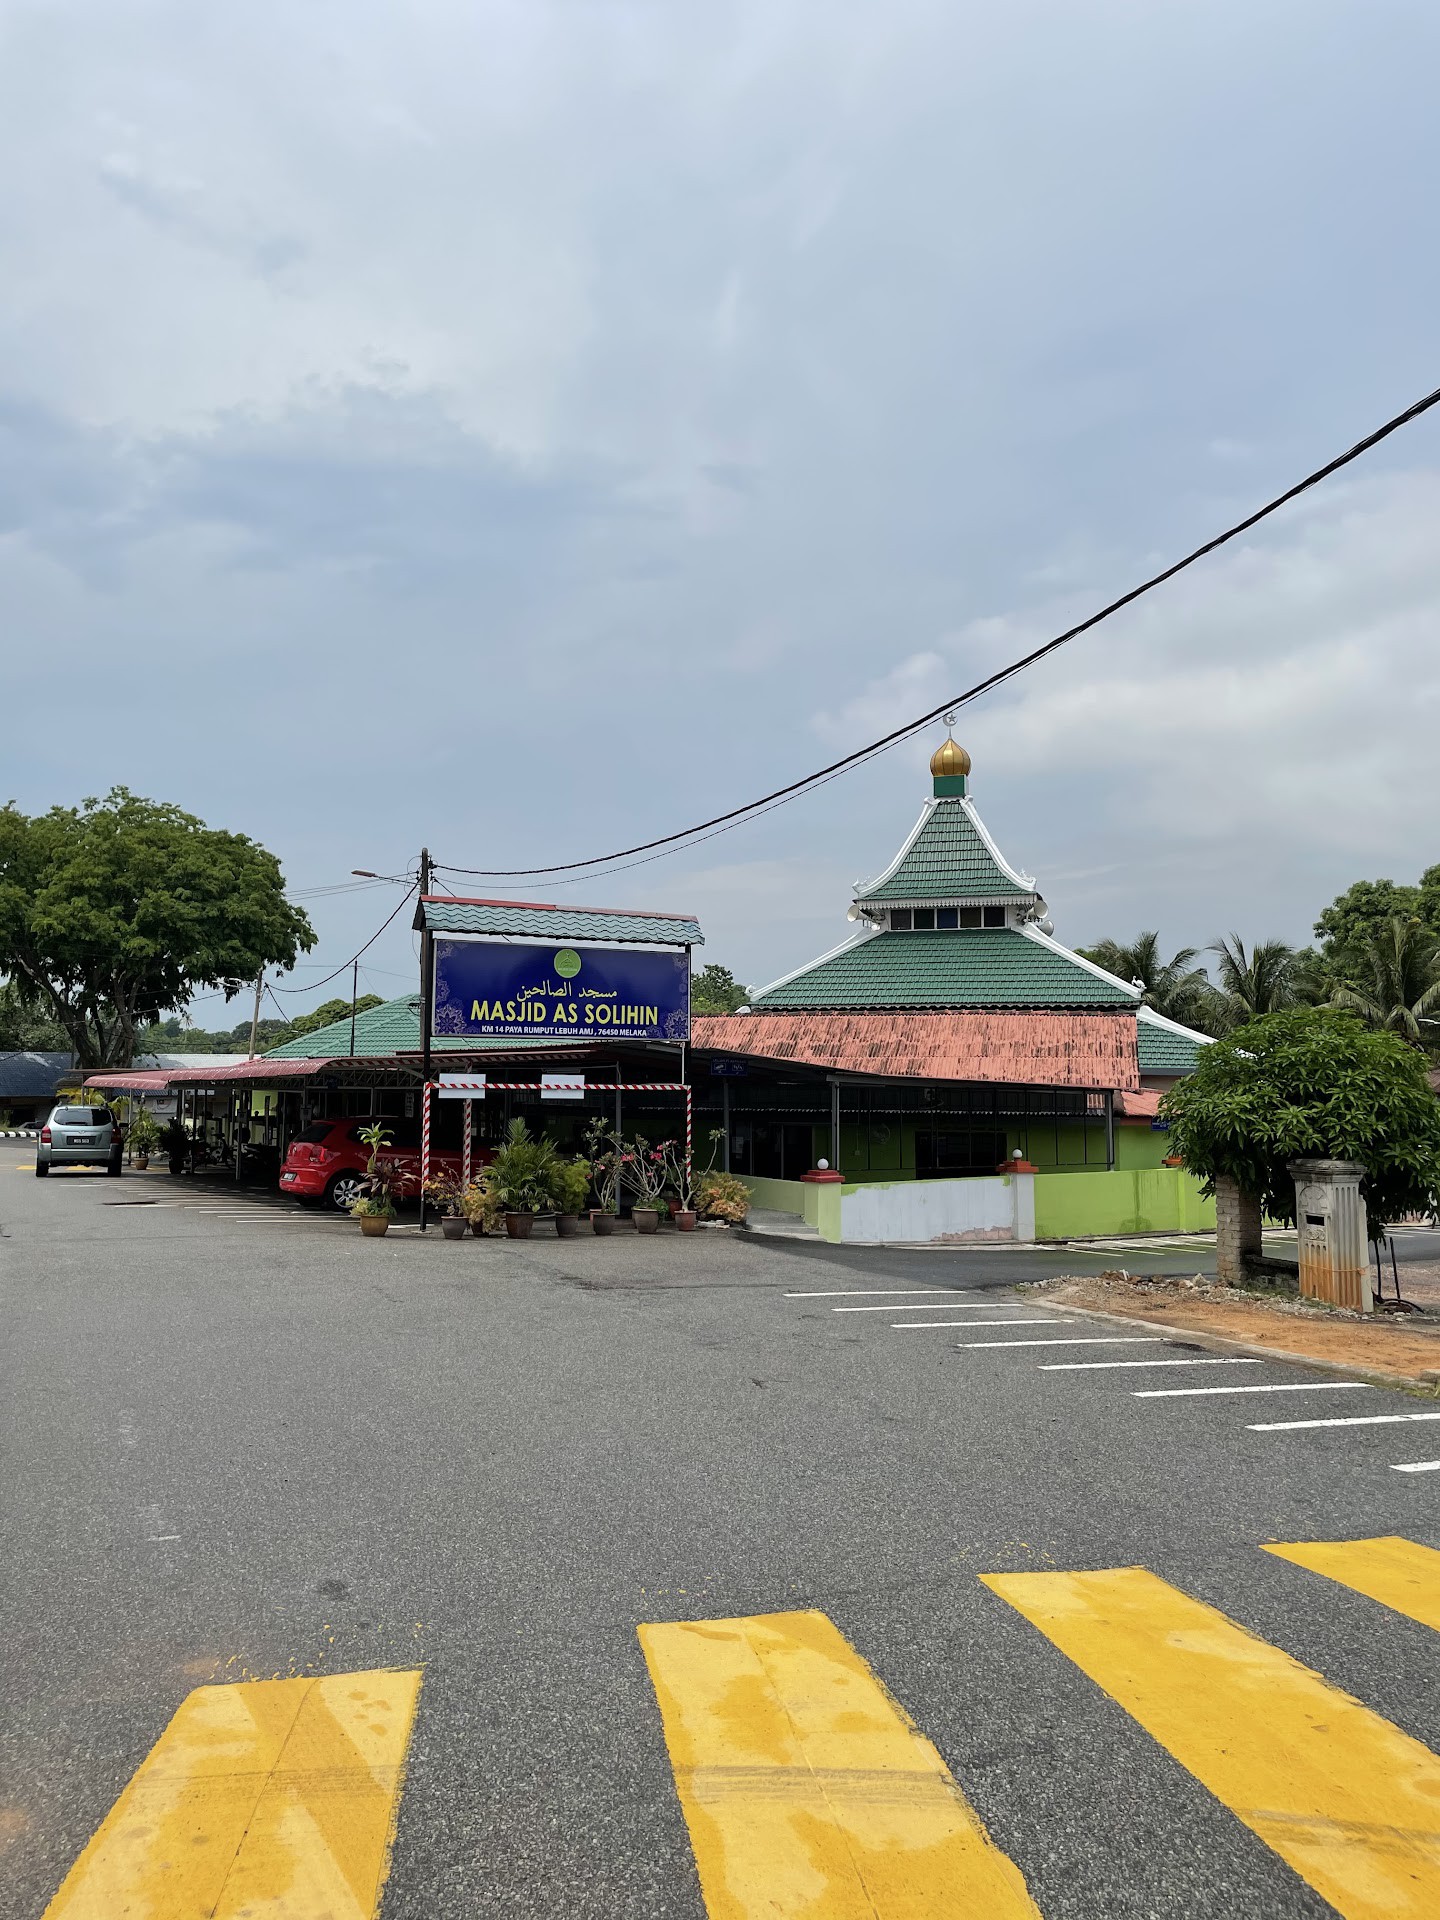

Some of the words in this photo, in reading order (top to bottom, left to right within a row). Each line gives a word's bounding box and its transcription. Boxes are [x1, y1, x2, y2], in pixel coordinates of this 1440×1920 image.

[517, 979, 572, 1002] الصالحين
[579, 987, 618, 999] مسجد
[470, 999, 546, 1022] MASJID
[552, 1003, 578, 1024] AS
[584, 1003, 658, 1025] SOLIHIN
[481, 1025, 494, 1033] KM
[504, 1026, 523, 1034] PAYA
[523, 1026, 554, 1034] RUMPUT
[555, 1027, 578, 1035] LEBUH
[598, 1028, 619, 1036] 76450
[619, 1028, 647, 1037] MELAKA
